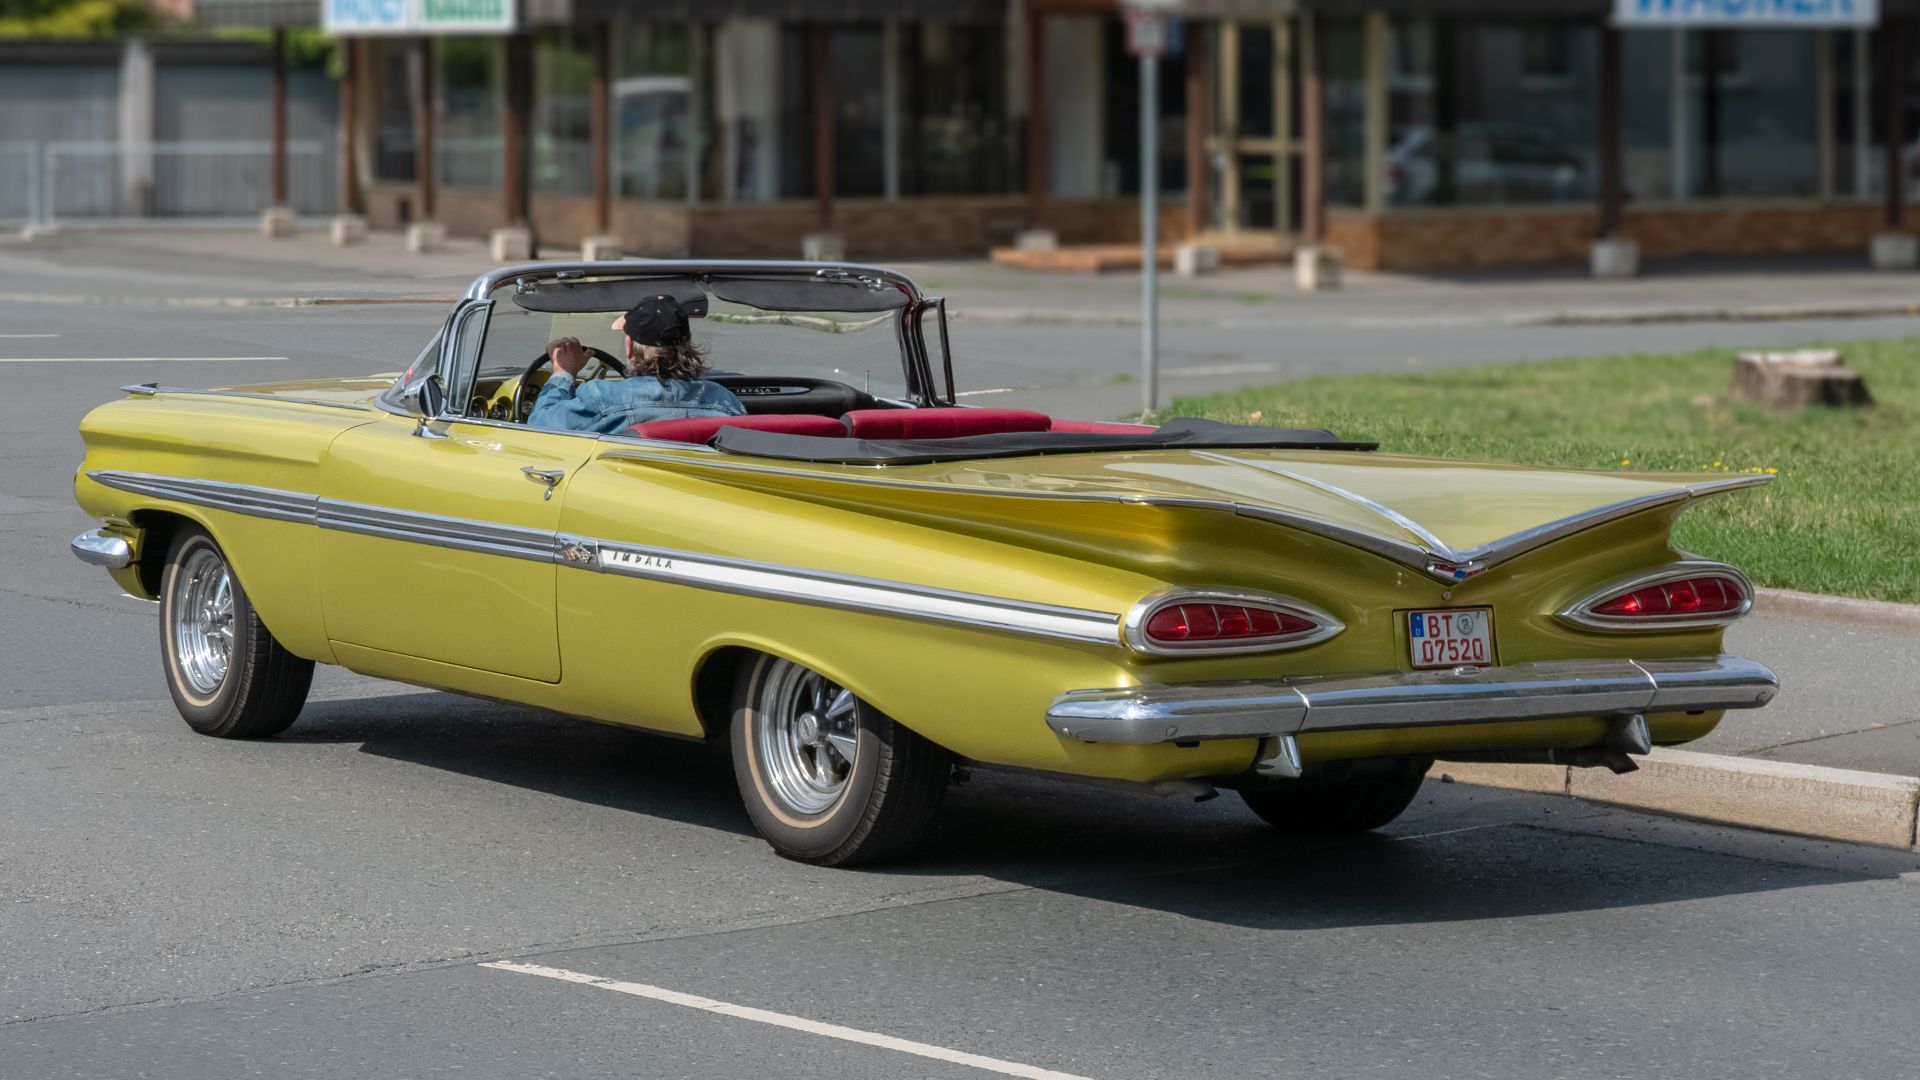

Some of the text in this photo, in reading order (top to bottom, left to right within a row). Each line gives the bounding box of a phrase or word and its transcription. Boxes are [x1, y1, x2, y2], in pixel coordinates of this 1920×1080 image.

[613, 552, 672, 568] IMPALA
[1428, 615, 1453, 638] BT
[1422, 638, 1484, 662] 07520
